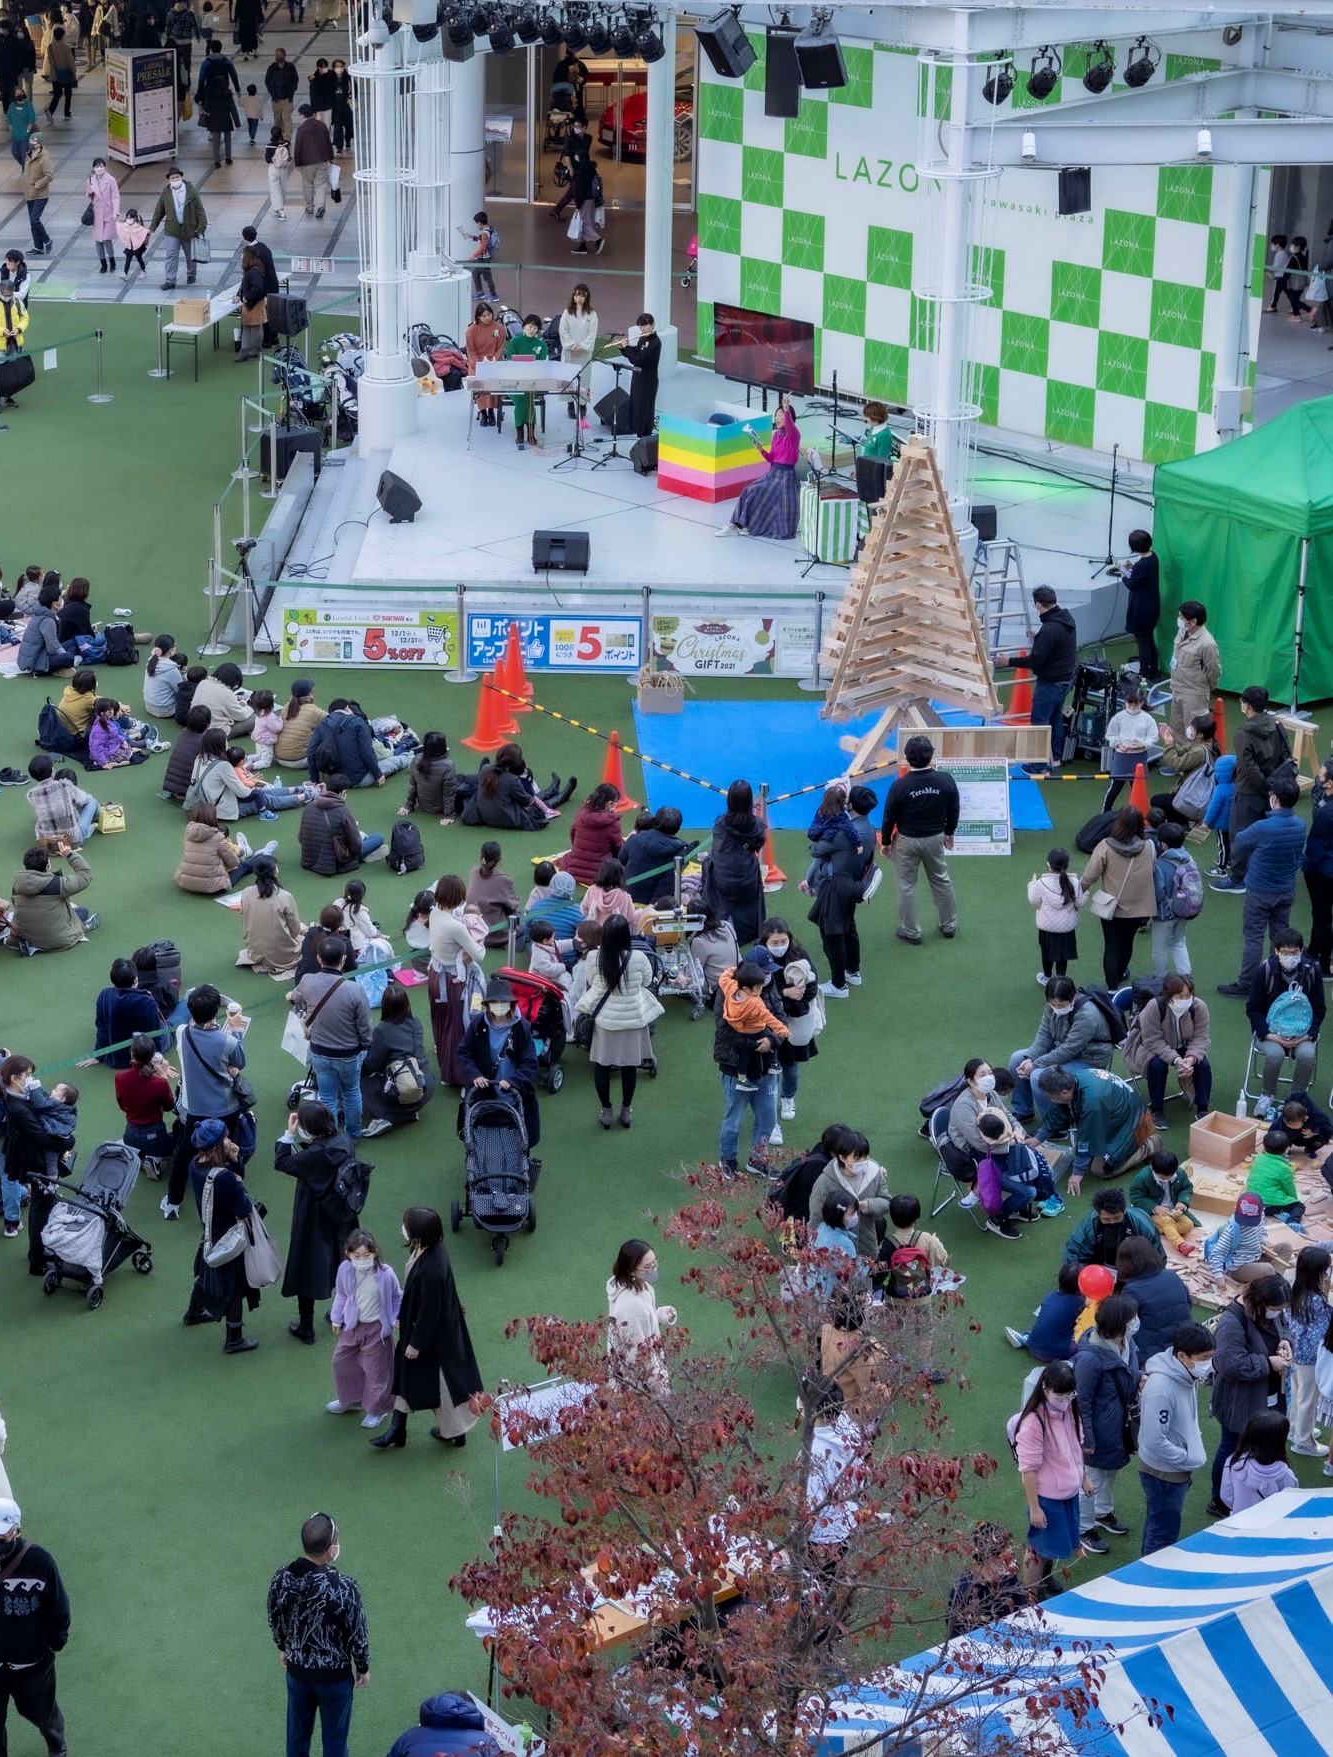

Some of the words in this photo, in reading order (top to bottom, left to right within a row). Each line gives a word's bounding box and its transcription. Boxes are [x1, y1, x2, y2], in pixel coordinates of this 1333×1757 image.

[1174, 57, 1205, 67] LAZONA
[708, 110, 732, 118] LAZONA
[790, 124, 815, 133] LAZONA
[748, 172, 772, 182] LAZONA
[836, 151, 943, 194] LAZO
[1166, 185, 1196, 196] LAZONA
[706, 221, 730, 230] LAZONA
[787, 236, 812, 246] LAZONA
[1110, 238, 1139, 250] LAZONA
[873, 253, 899, 263] LAZONA
[745, 282, 769, 292] LAZONA
[1058, 290, 1086, 300] LAZONA
[829, 300, 854, 310] LAZONA
[1158, 310, 1188, 321] LAZONA
[1007, 339, 1035, 350] LAZONA
[1104, 360, 1133, 370] LAZONA
[870, 366, 895, 376] LAZONA
[1052, 408, 1080, 419] LAZONA
[1151, 431, 1180, 442] LAZONA
[493, 619, 545, 637] ポント
[577, 626, 602, 661] 5
[714, 634, 741, 642] LAZONA
[676, 635, 746, 662] Christmas
[604, 649, 636, 661] ポイント
[695, 659, 720, 670] GIFT
[909, 787, 940, 798] TeraMax
[1159, 1409, 1169, 1424] 3
